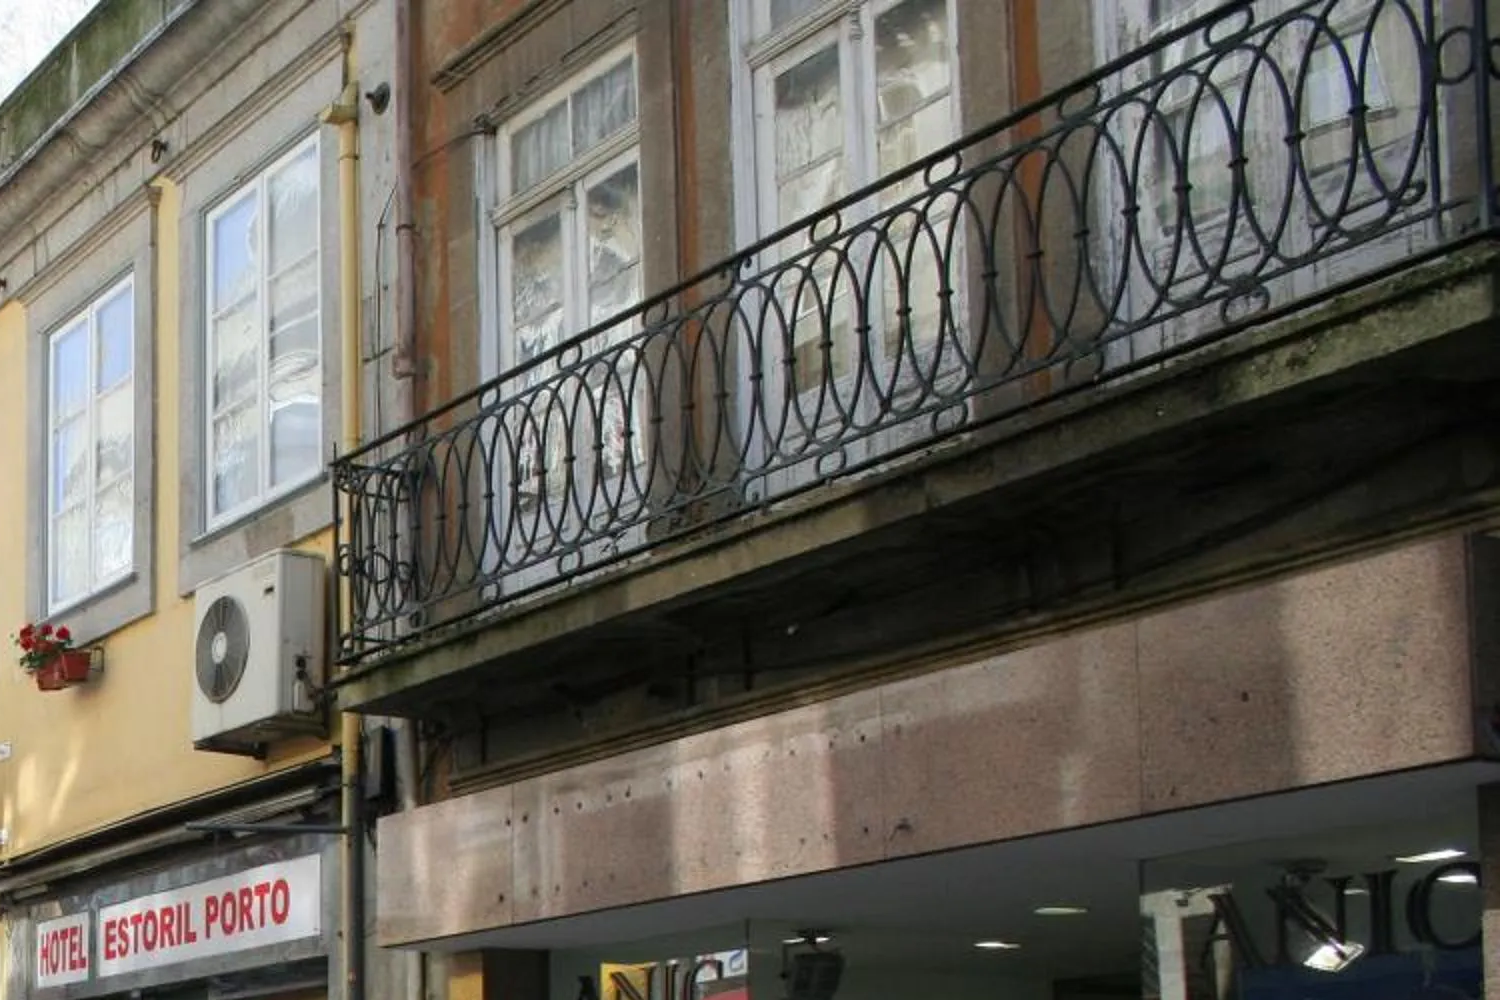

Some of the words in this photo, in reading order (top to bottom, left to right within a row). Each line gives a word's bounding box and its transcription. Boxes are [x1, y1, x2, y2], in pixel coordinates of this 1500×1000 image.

[40, 923, 86, 976] HOTEL
[103, 902, 197, 960] ESTORIL
[205, 879, 290, 938] PORTO
